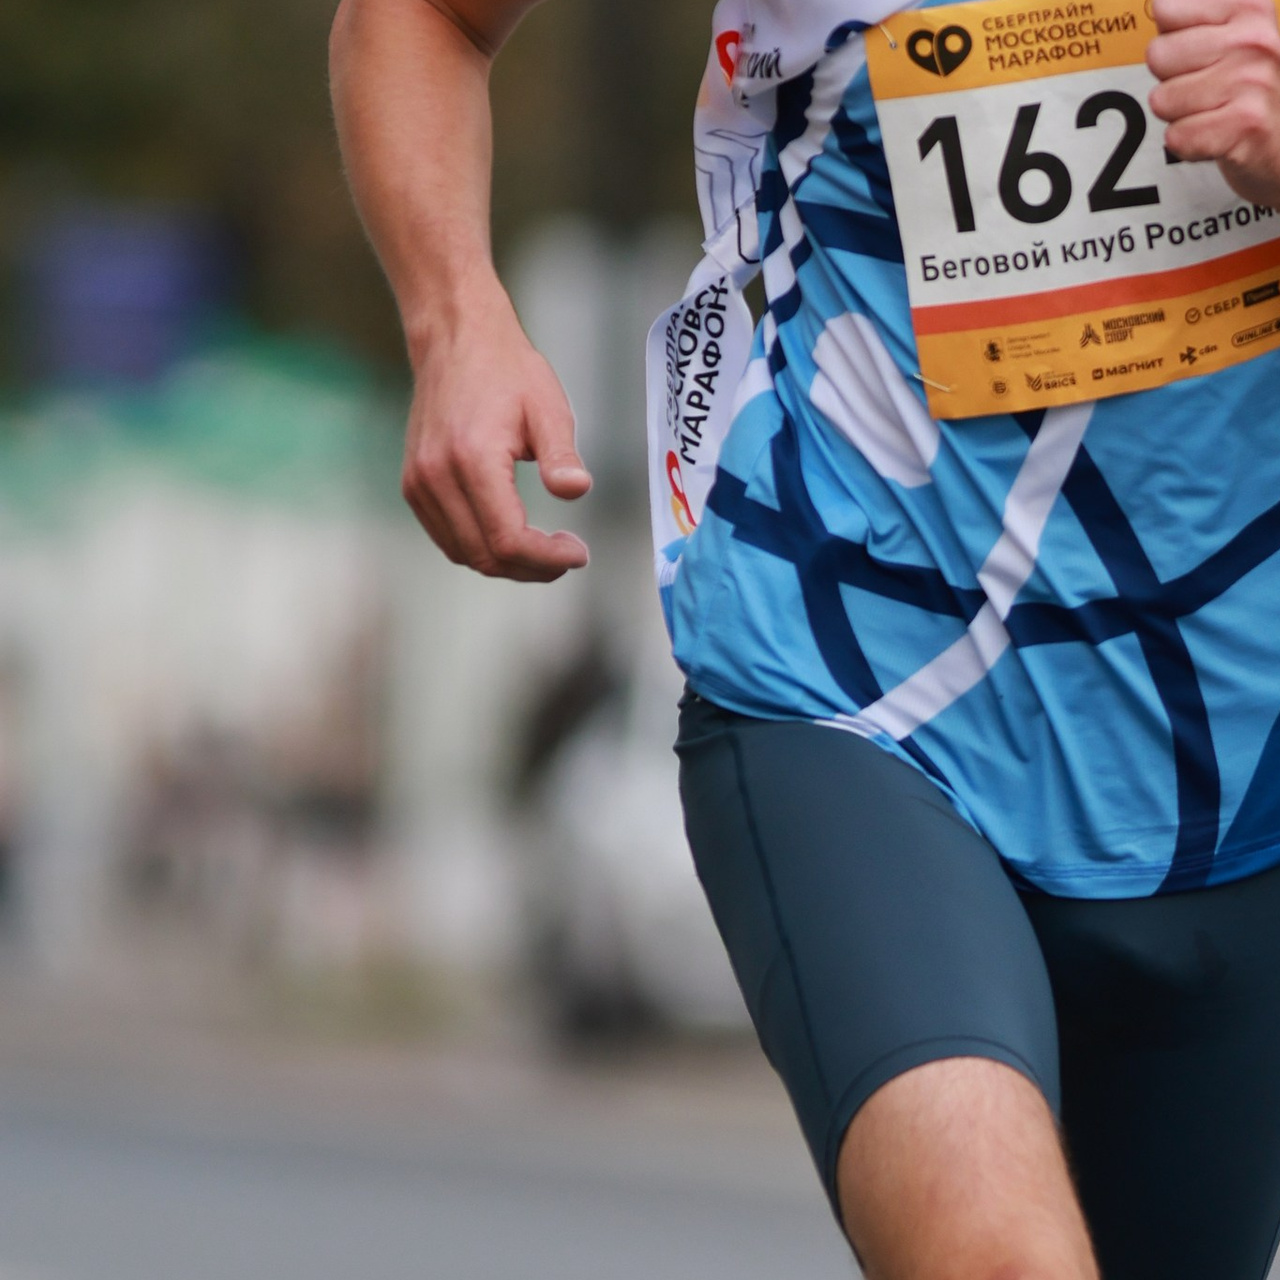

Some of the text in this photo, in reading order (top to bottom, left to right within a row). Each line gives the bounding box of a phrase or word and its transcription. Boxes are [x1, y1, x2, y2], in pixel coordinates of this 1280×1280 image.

[982, 1, 1095, 32] СБЕРПРАЙМ
[985, 11, 1137, 52] МОСКОВСКИЙ
[988, 39, 1101, 72] МАРАФОН
[917, 90, 1215, 233] 162
[920, 204, 1274, 282] Беговой клуб Росатом
[1102, 308, 1166, 330] МОСКОВСКИЙ
[1203, 297, 1241, 317] СБЕР
[1104, 326, 1134, 345] СПОРТ
[680, 284, 729, 466] МАРАФОН
